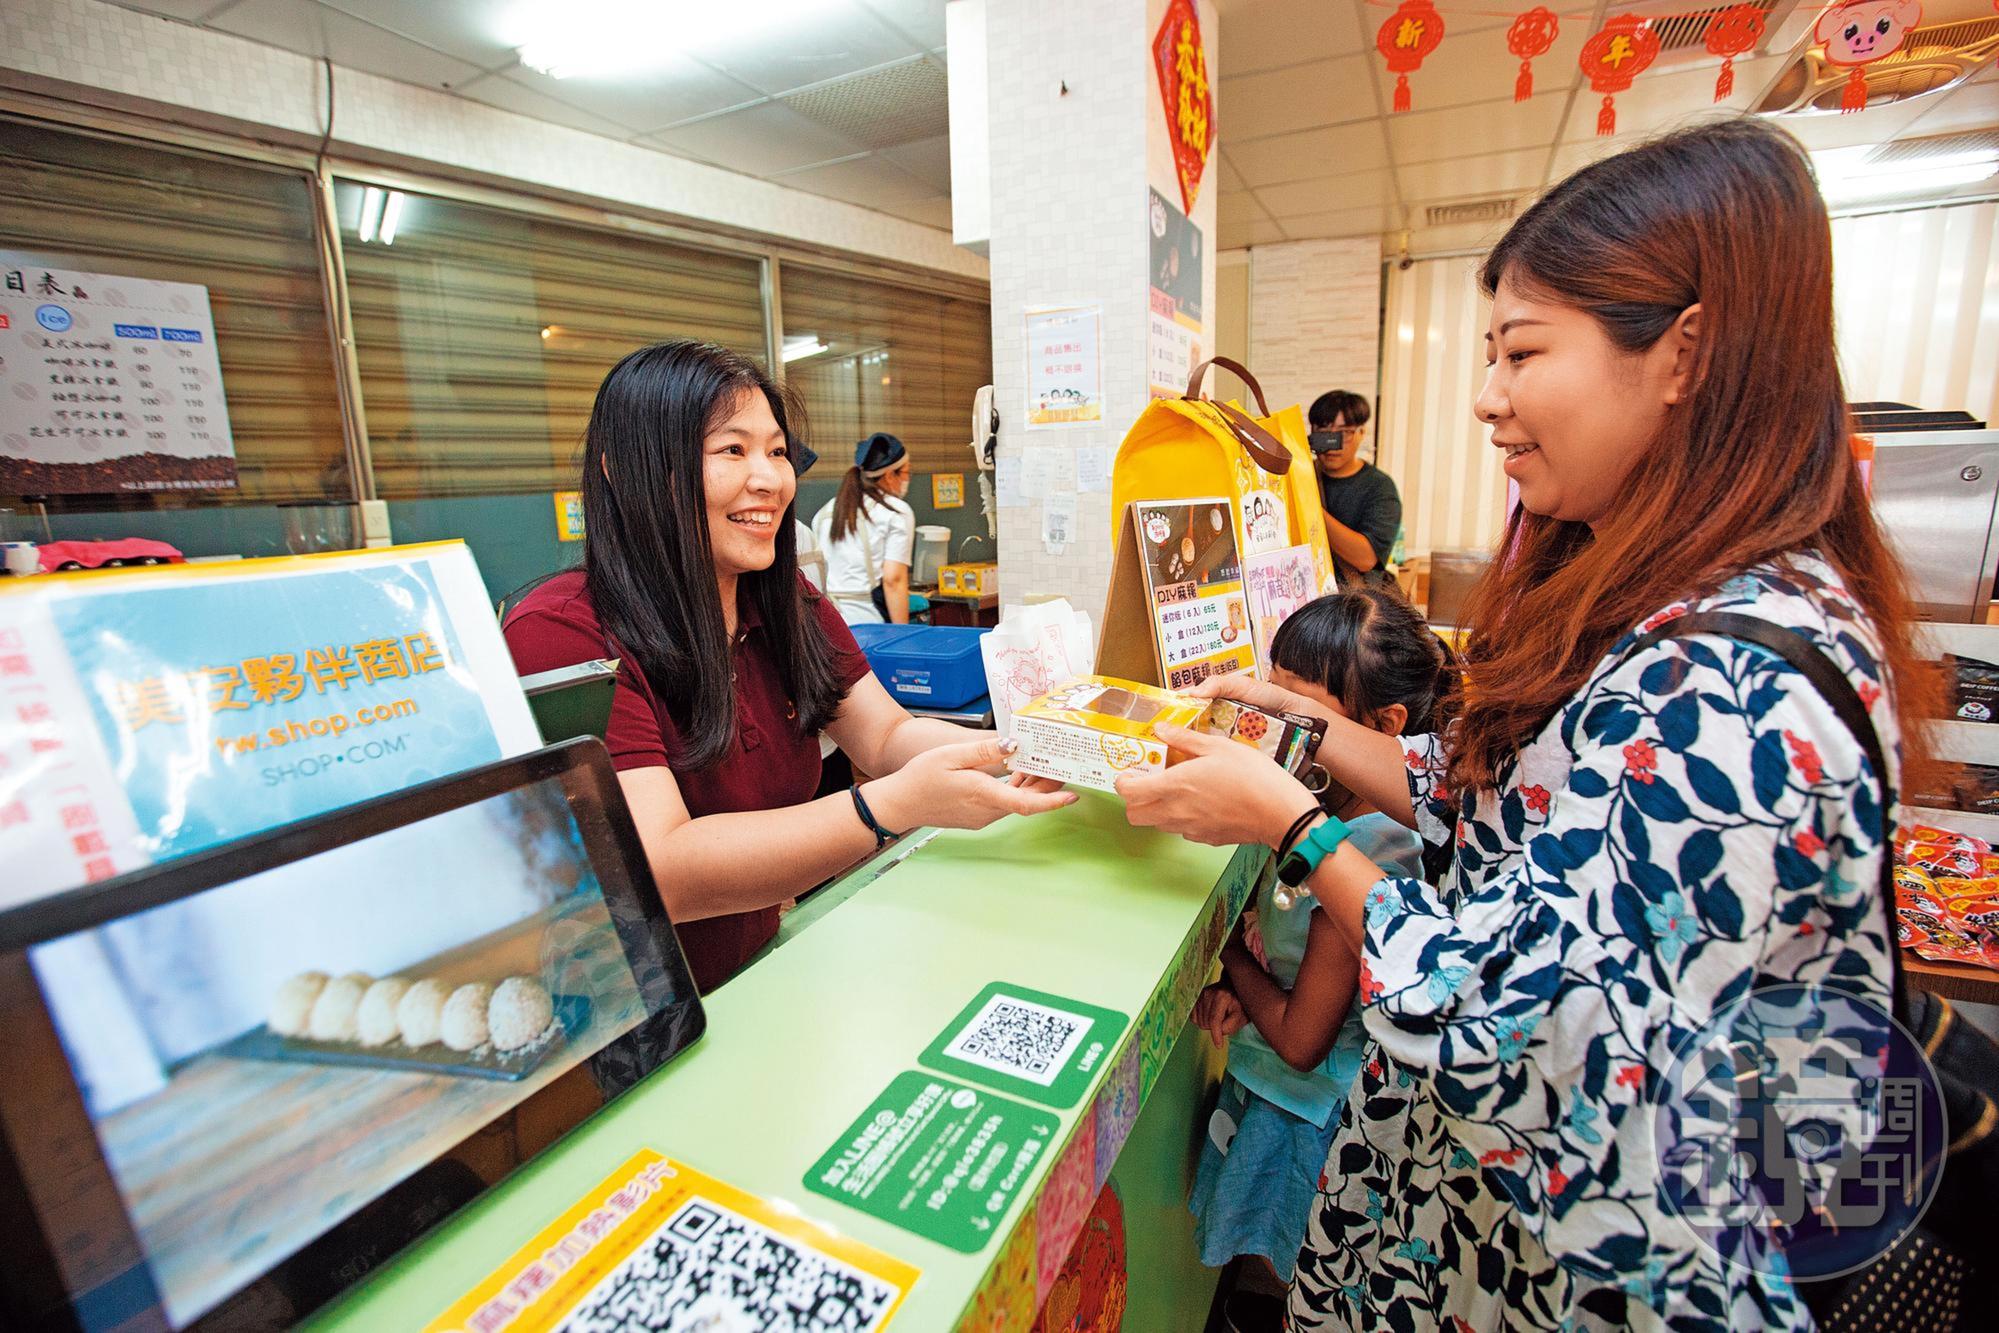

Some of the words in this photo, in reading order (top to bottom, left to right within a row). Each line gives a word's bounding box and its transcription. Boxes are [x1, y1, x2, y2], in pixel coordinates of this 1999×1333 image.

[1395, 17, 1425, 49] 新
[1601, 35, 1635, 69] 年
[1157, 582, 1197, 603] DIY麻糬
[119, 630, 447, 732] 美安夥伴商店
